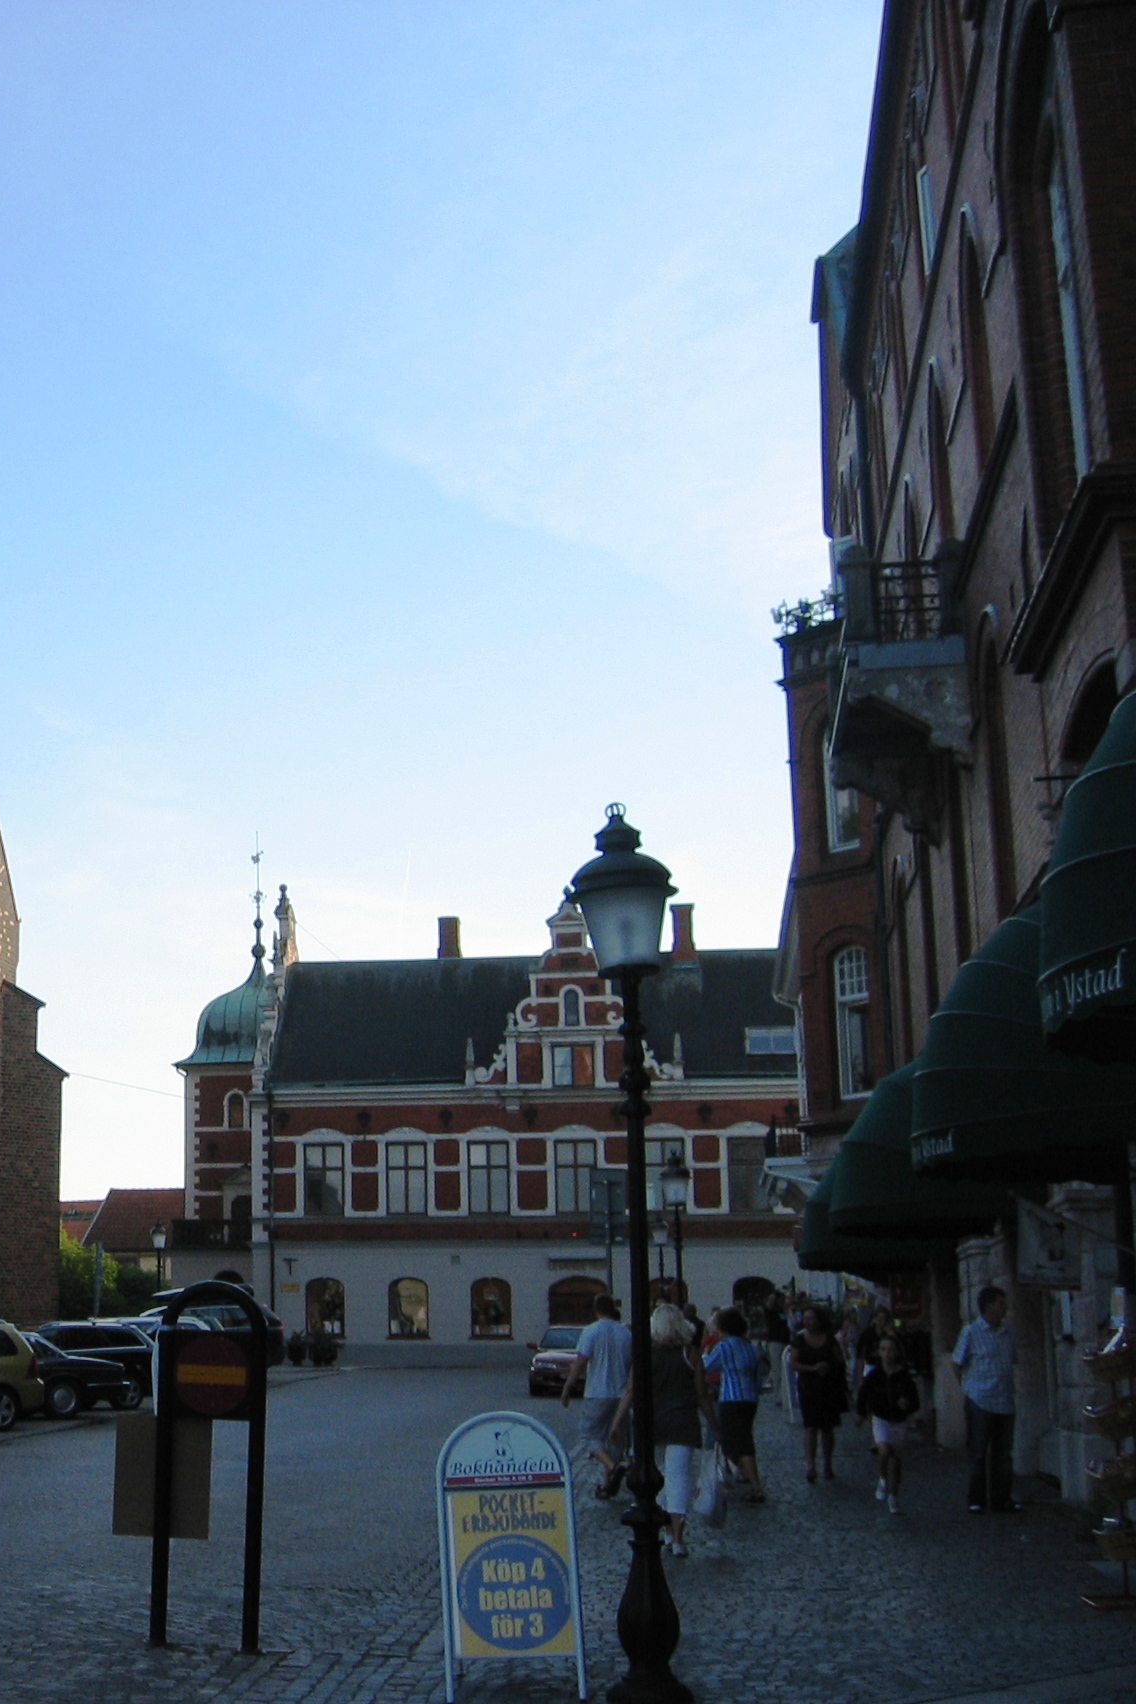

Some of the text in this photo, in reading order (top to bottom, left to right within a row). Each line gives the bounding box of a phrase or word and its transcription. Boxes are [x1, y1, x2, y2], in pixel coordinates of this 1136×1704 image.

[1062, 947, 1128, 1015] Ystad
[450, 1456, 555, 1476] Bokhandeln
[478, 1491, 545, 1514] POCKET-
[461, 1510, 557, 1534] ERBJUDANDE
[481, 1557, 526, 1584] Köp
[531, 1556, 546, 1581] 4
[478, 1585, 553, 1611] betala
[490, 1612, 545, 1639] för 3
